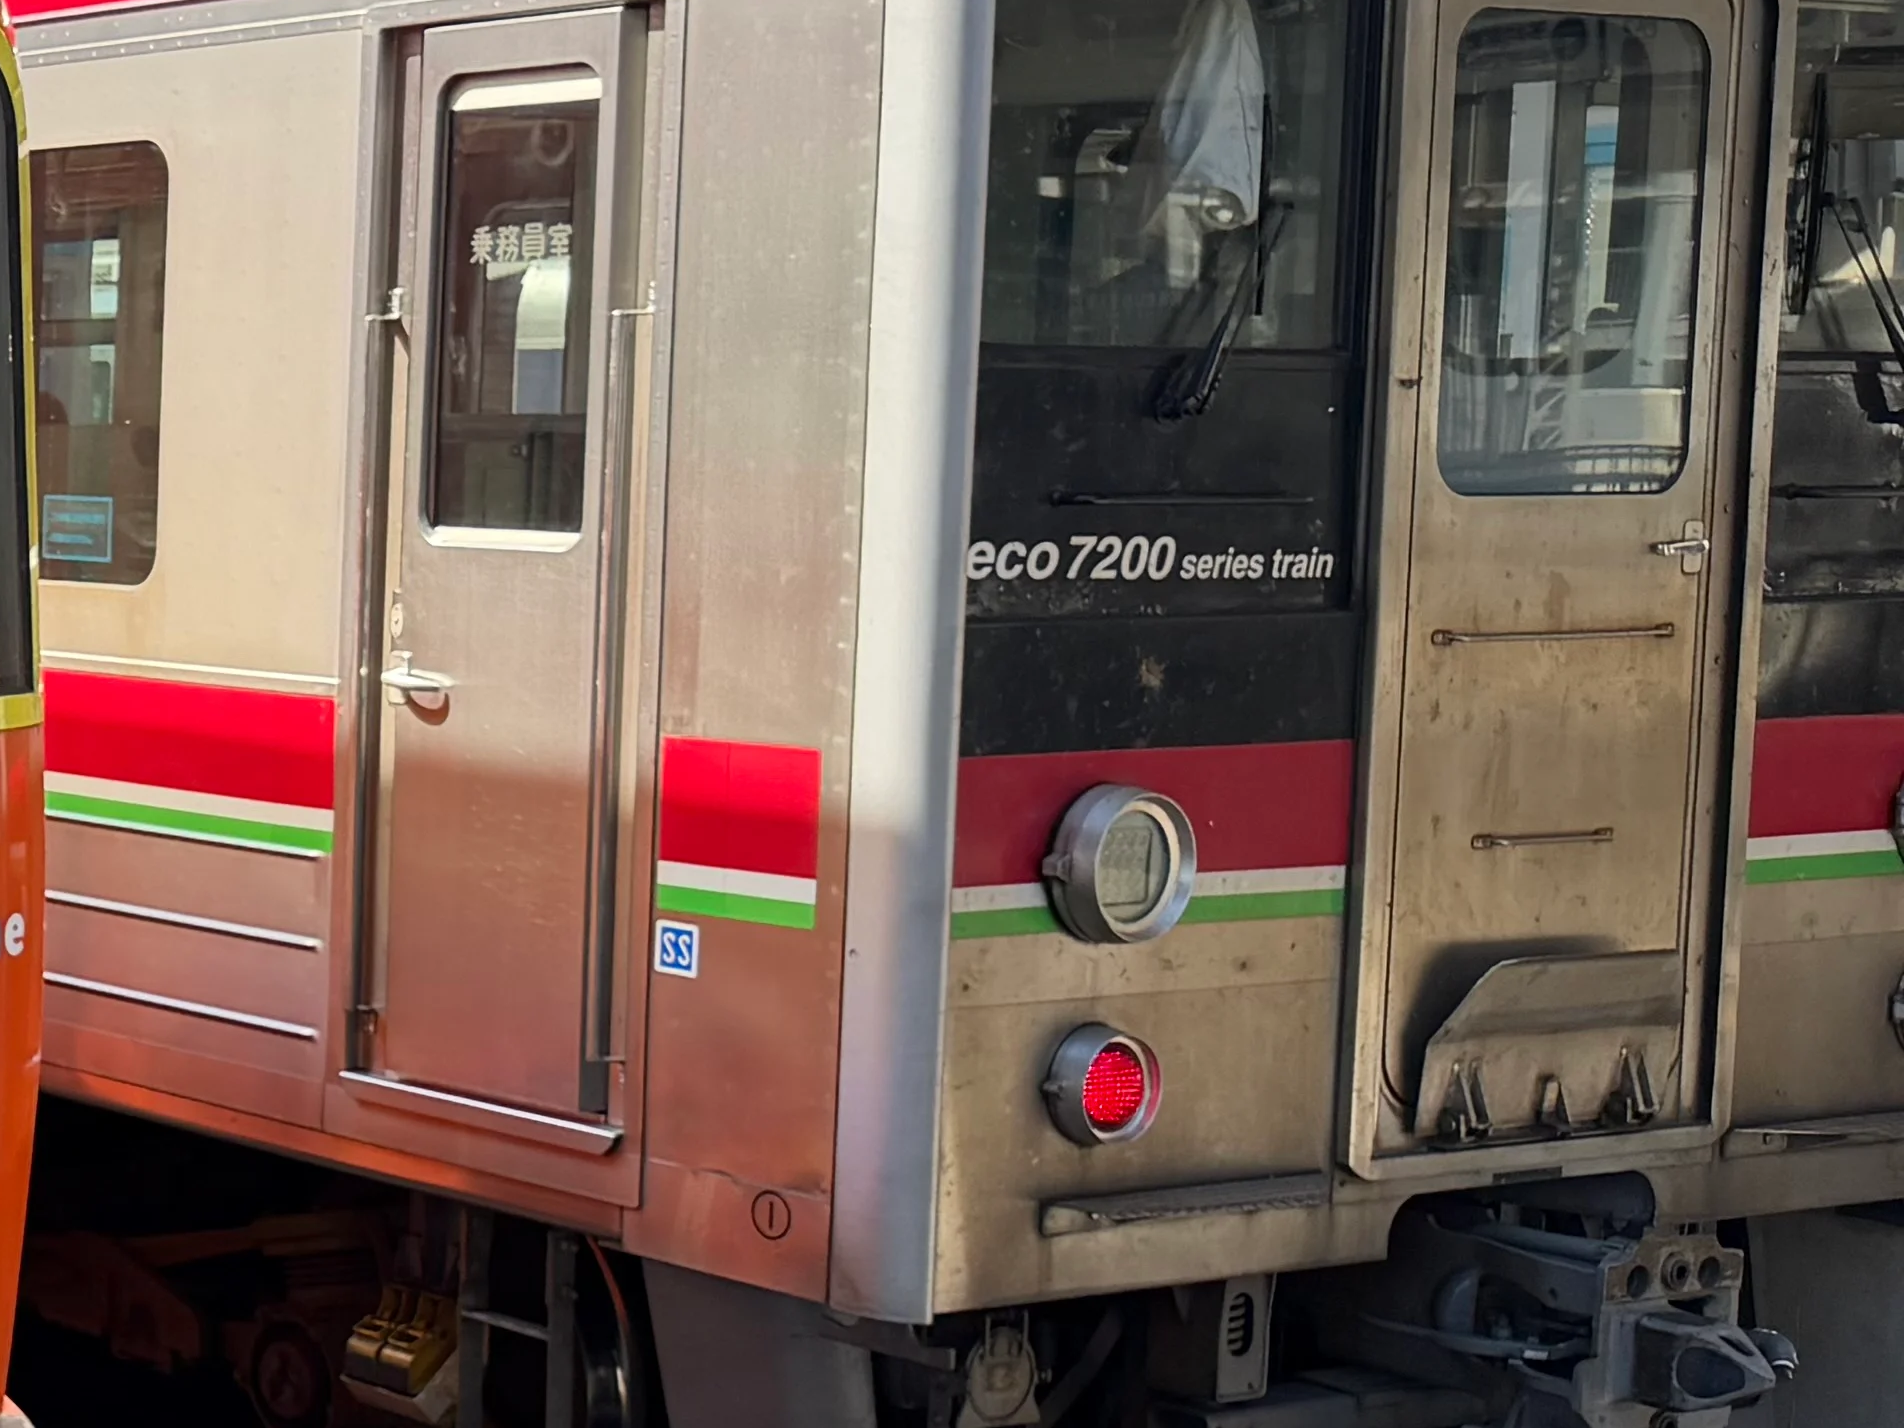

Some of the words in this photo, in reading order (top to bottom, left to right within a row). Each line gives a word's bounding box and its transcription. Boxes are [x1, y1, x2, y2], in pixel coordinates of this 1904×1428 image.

[470, 222, 572, 264] 乗務員室
[965, 540, 1060, 581] eco
[1065, 535, 1177, 581] 7200
[1180, 546, 1265, 580] series
[1271, 546, 1334, 580] train
[661, 931, 692, 968] SS
